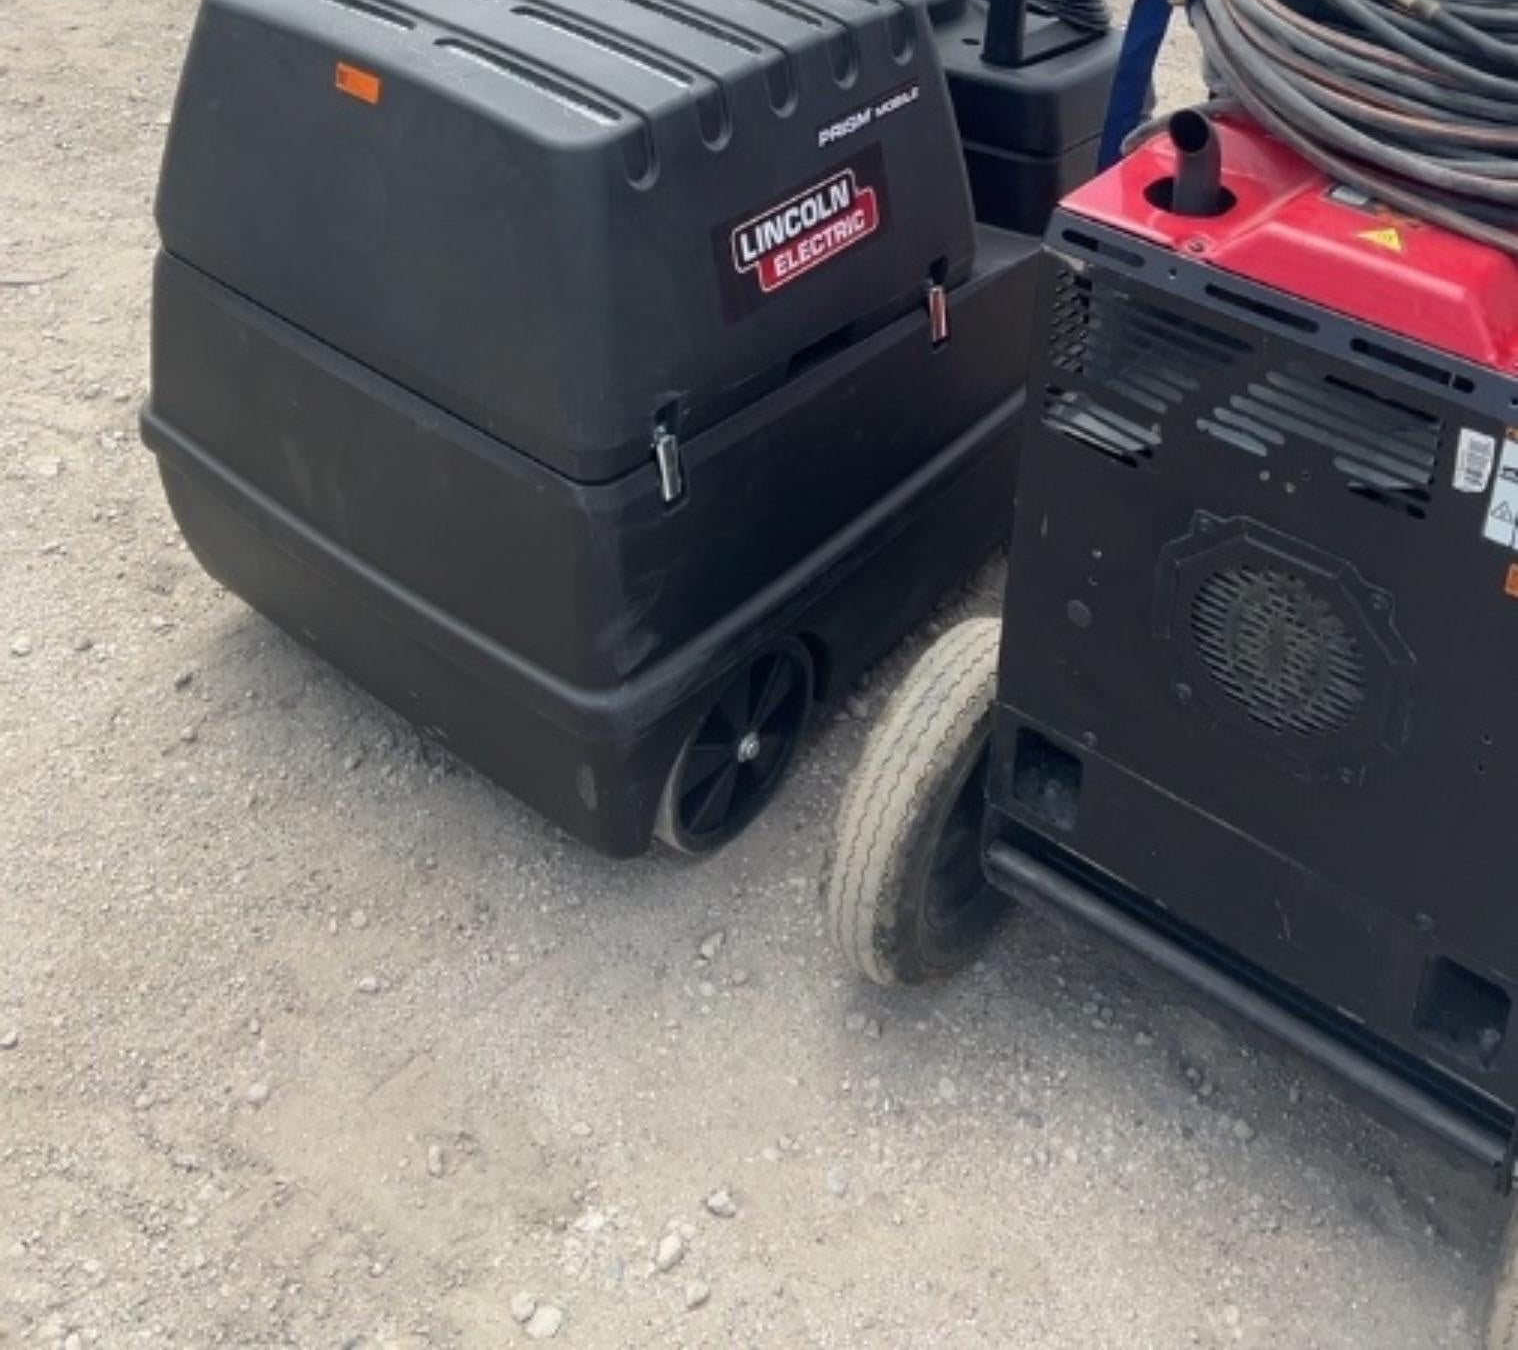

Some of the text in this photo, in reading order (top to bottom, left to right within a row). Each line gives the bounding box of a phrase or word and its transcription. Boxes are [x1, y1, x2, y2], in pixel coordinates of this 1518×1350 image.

[818, 86, 920, 148] PRISM MOBILE
[739, 178, 850, 262] LINCOLN
[773, 208, 866, 277] ELECTRIC
